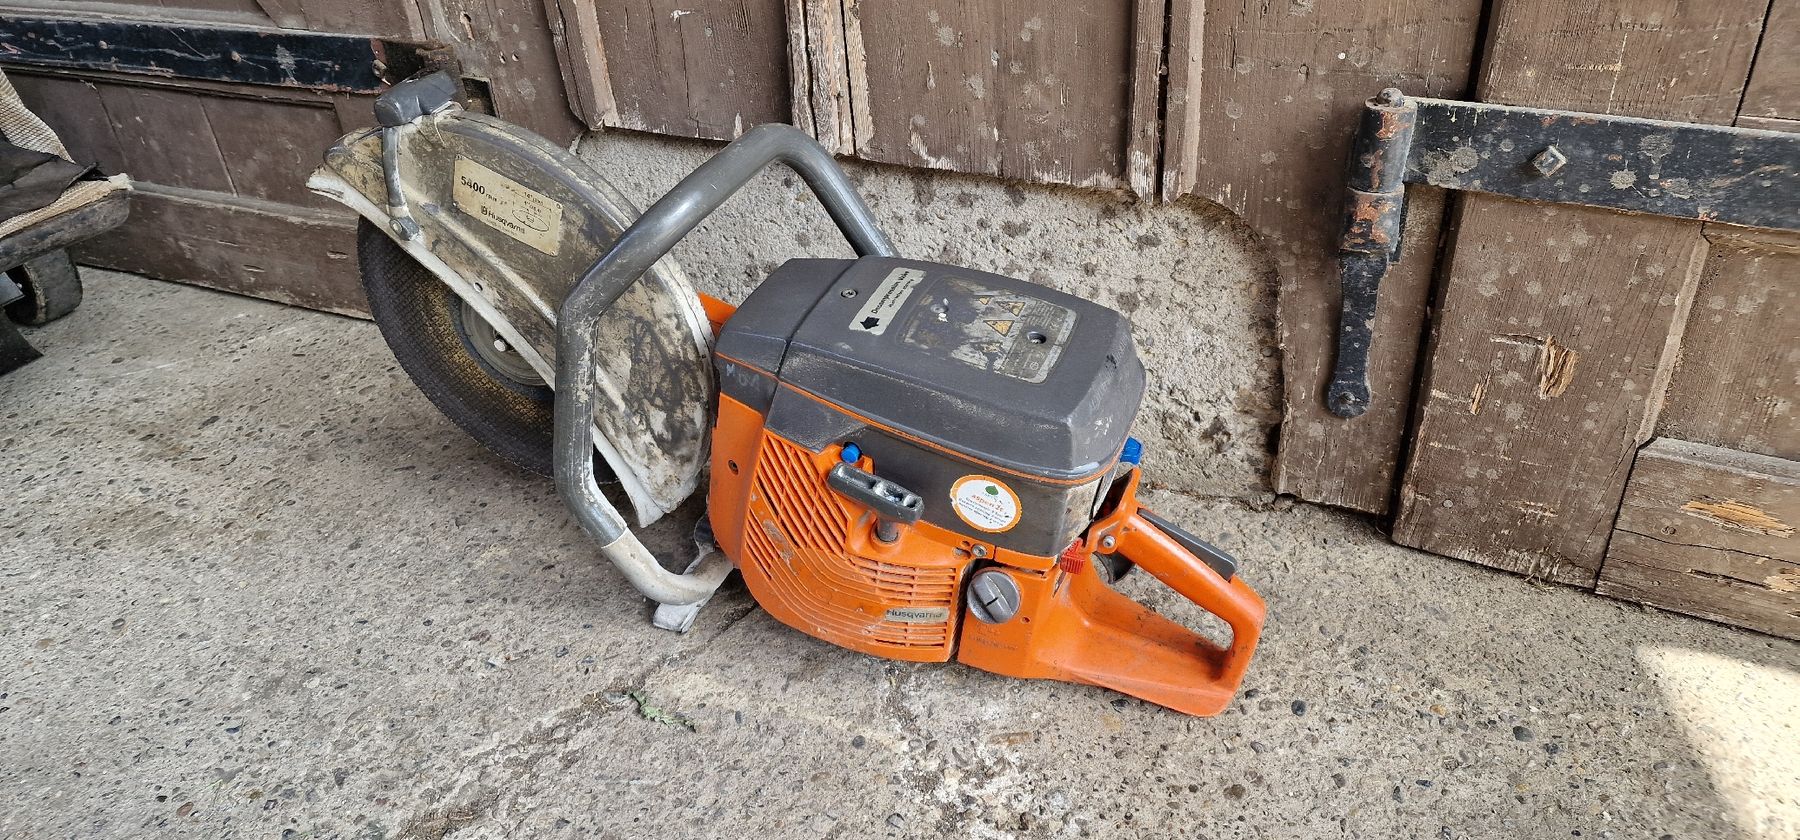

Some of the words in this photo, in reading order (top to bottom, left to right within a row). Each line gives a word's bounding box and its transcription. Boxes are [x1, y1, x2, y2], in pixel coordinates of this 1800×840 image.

[460, 175, 486, 194] 5400
[488, 210, 525, 234] Husqvarna
[871, 281, 901, 314] Decompression
[971, 494, 995, 507] aspen
[886, 609, 943, 619] Husqvarna
